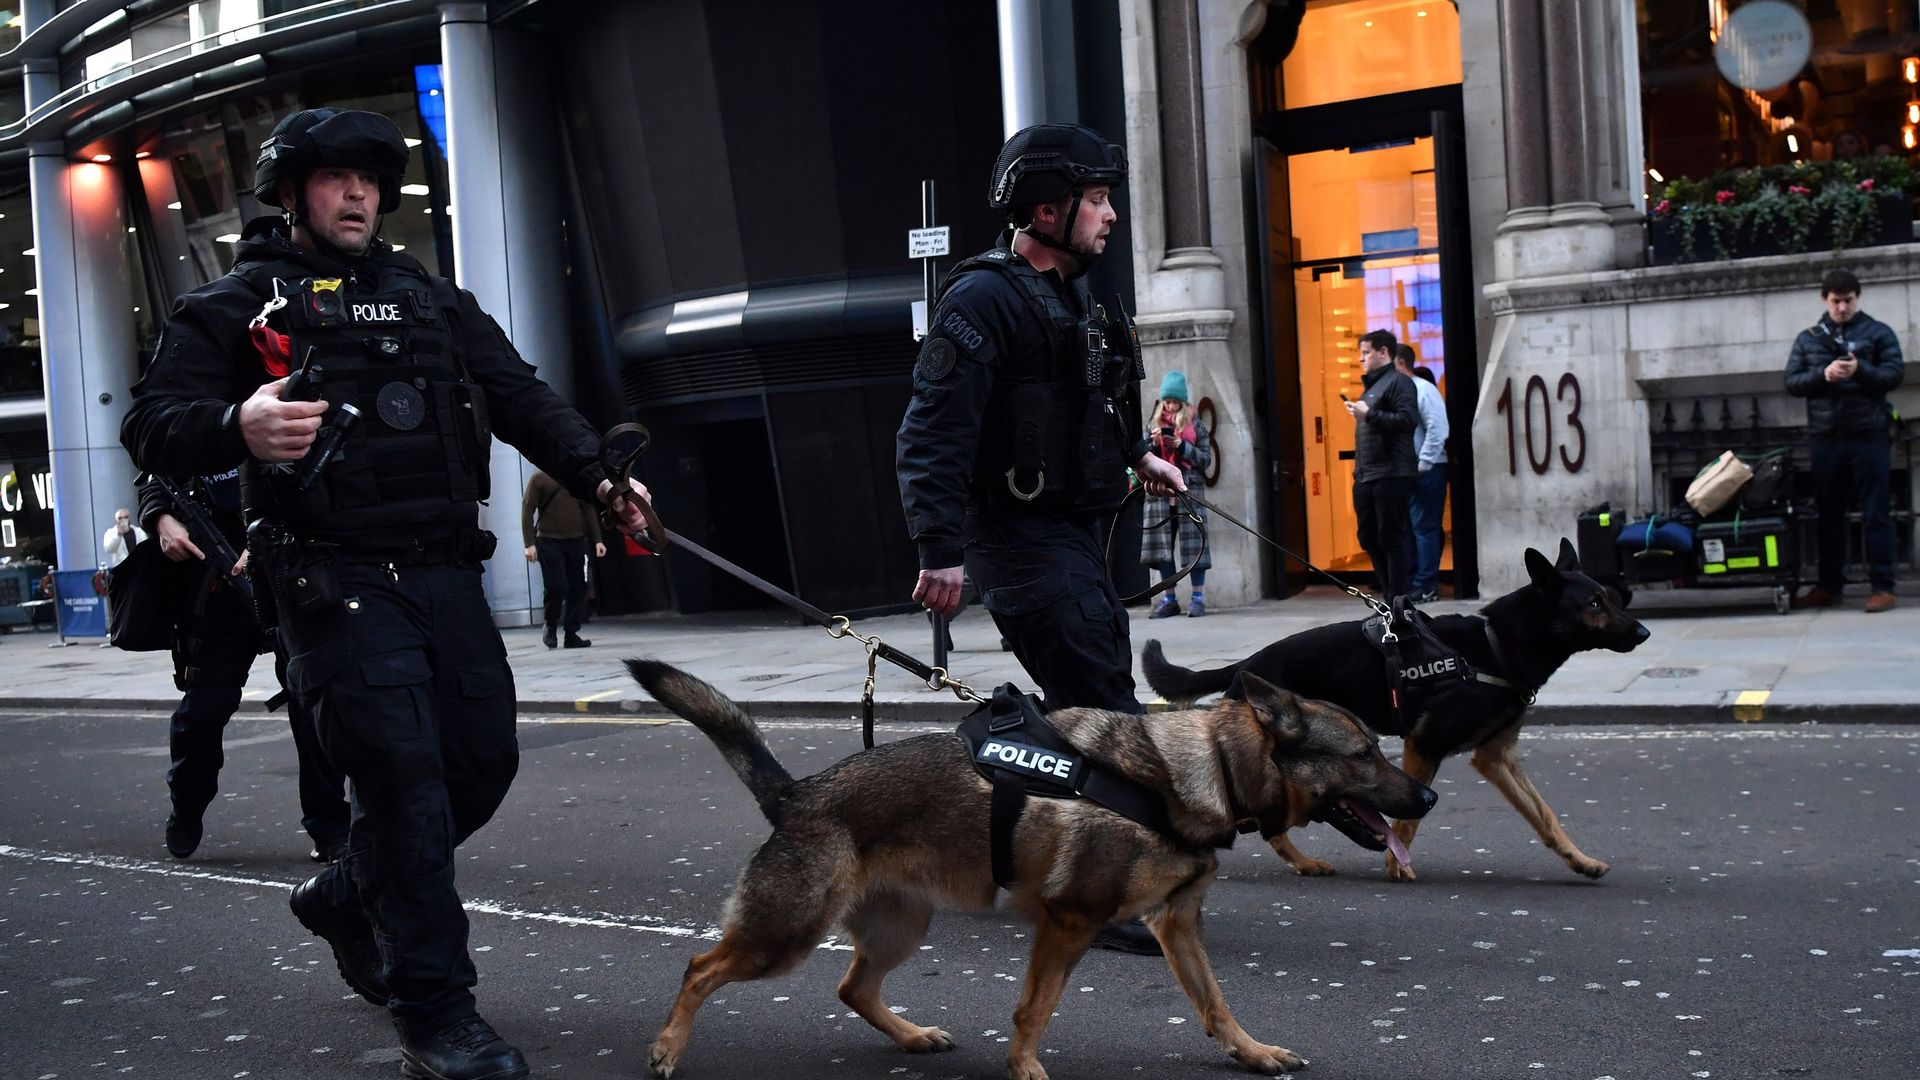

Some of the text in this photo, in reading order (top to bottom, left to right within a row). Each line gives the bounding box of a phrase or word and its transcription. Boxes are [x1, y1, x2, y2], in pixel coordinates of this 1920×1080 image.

[352, 303, 403, 322] POLICE
[1496, 372, 1586, 476] 103
[212, 467, 240, 482] POLICE
[1400, 657, 1457, 680] POLICE
[983, 742, 1073, 779] POLICE
